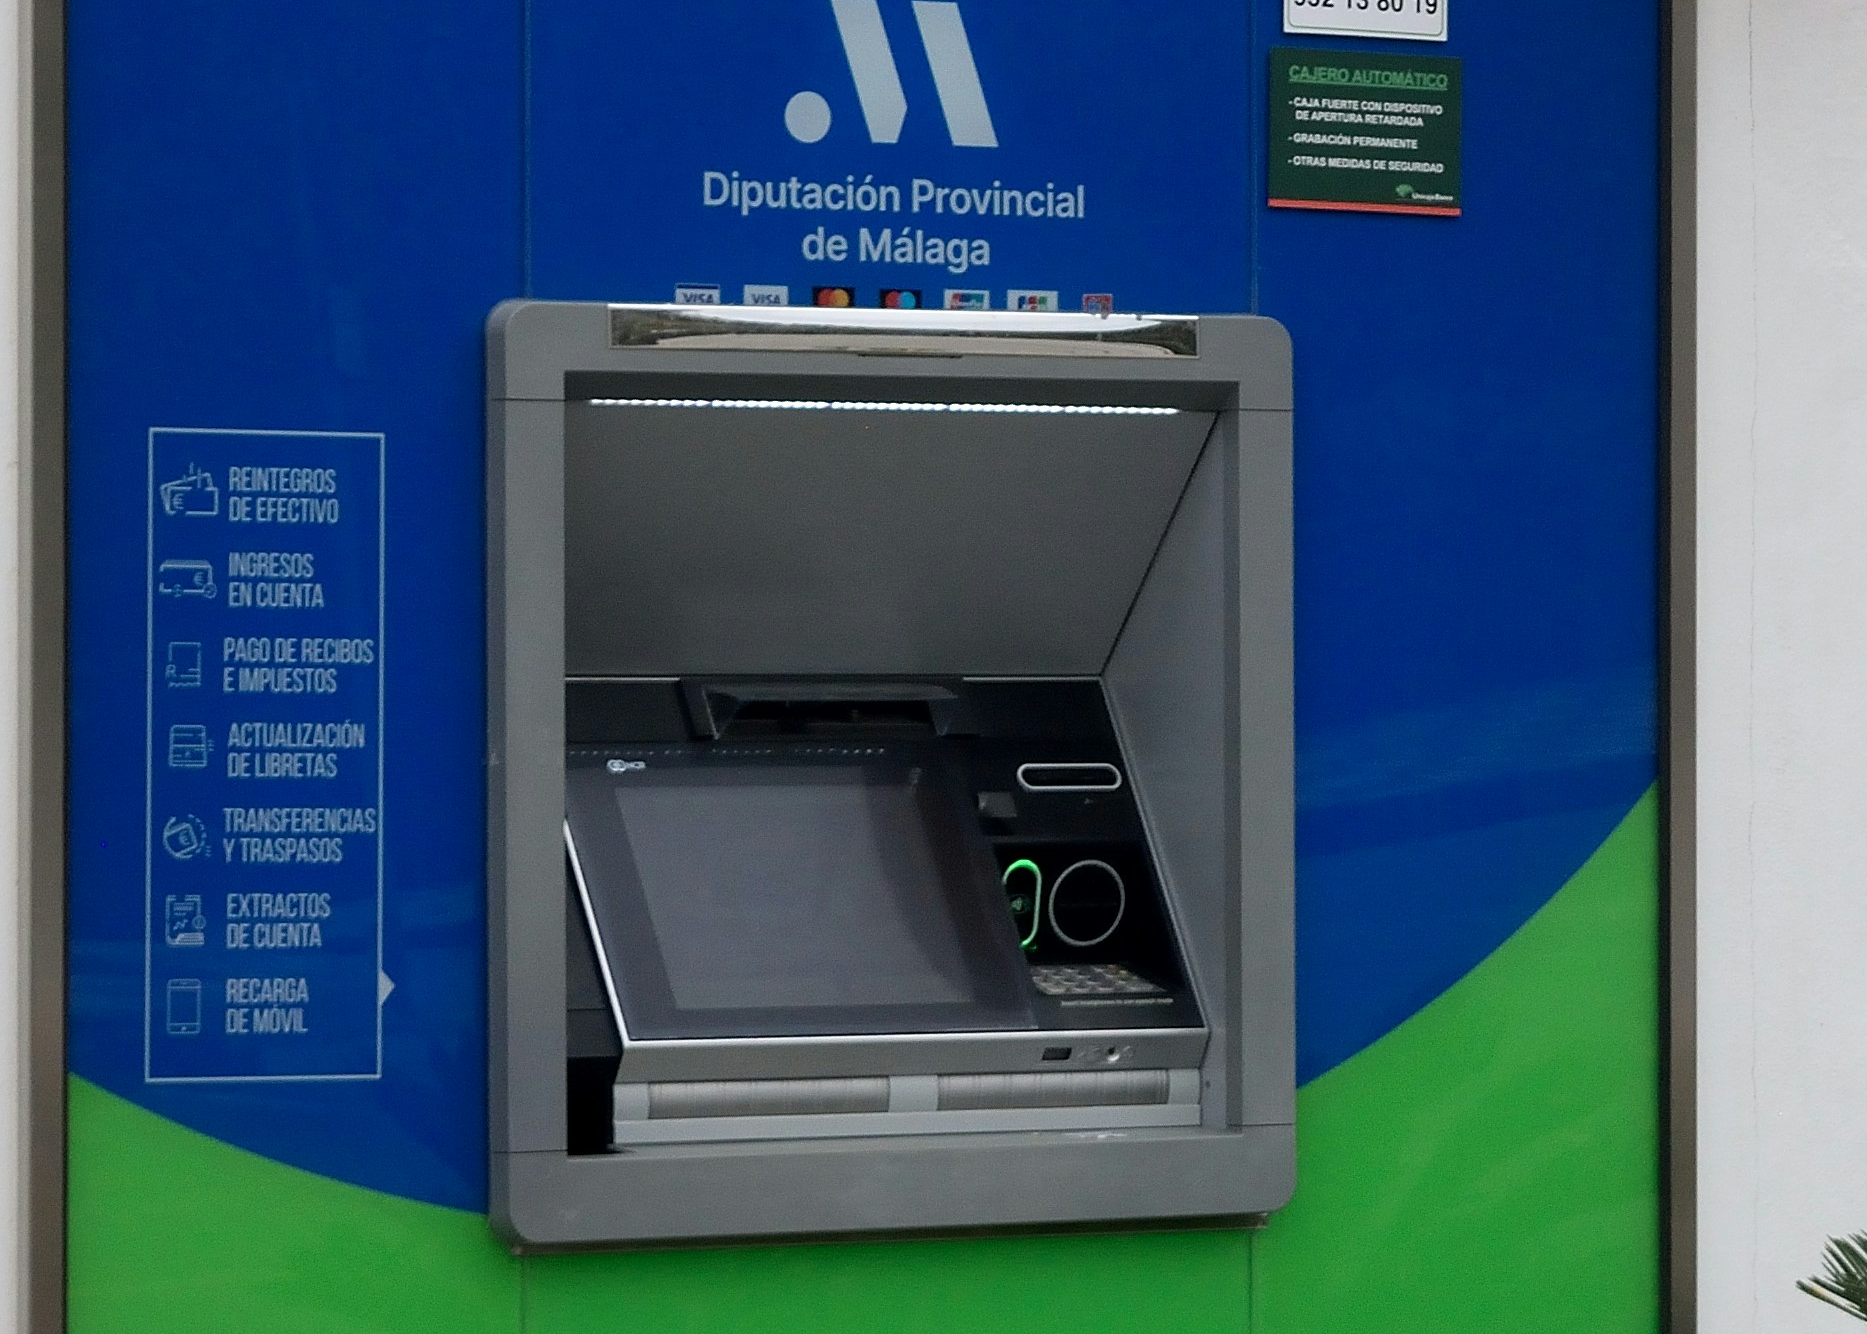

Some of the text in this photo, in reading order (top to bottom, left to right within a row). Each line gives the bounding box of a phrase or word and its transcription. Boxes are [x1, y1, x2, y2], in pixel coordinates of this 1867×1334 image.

[1289, 65, 1448, 88] CAJERO AUTOMÁTICO
[1295, 110, 1310, 120] DE
[1311, 111, 1363, 124] APERTURA
[1322, 98, 1359, 111] FUERTE
[1361, 101, 1382, 112] CON
[1384, 102, 1443, 115] DISPOSITIVO
[1353, 137, 1418, 149] PERMANENTE
[1329, 158, 1371, 170] MEDIDAS
[1373, 160, 1386, 170] DE
[1388, 161, 1444, 173] SEGURIDAD
[703, 171, 1085, 219] Diputación Provincial
[802, 227, 990, 273] de Málaga
[682, 292, 714, 304] VISA
[752, 293, 781, 305] VISA
[228, 467, 337, 494] REINTEGROS
[228, 497, 340, 524] DE EFECTIVO
[228, 552, 314, 578] INGRESOS
[228, 582, 325, 608] EN CUENTA
[223, 637, 374, 664] PAGO DE RECIBOS
[223, 667, 337, 694] E IMPUESTOS
[227, 719, 364, 749] ACTUALIZACIÓN
[227, 753, 338, 779] DE LIBRETAS
[223, 807, 376, 833] TRANSFERENCIAS
[222, 838, 342, 863] Y TRASPASOS
[226, 893, 331, 918] EXTRACTOS
[226, 923, 322, 949] DE CUENTA
[225, 978, 309, 1003] RECARGA
[225, 1004, 308, 1034] DE MÓVIL
